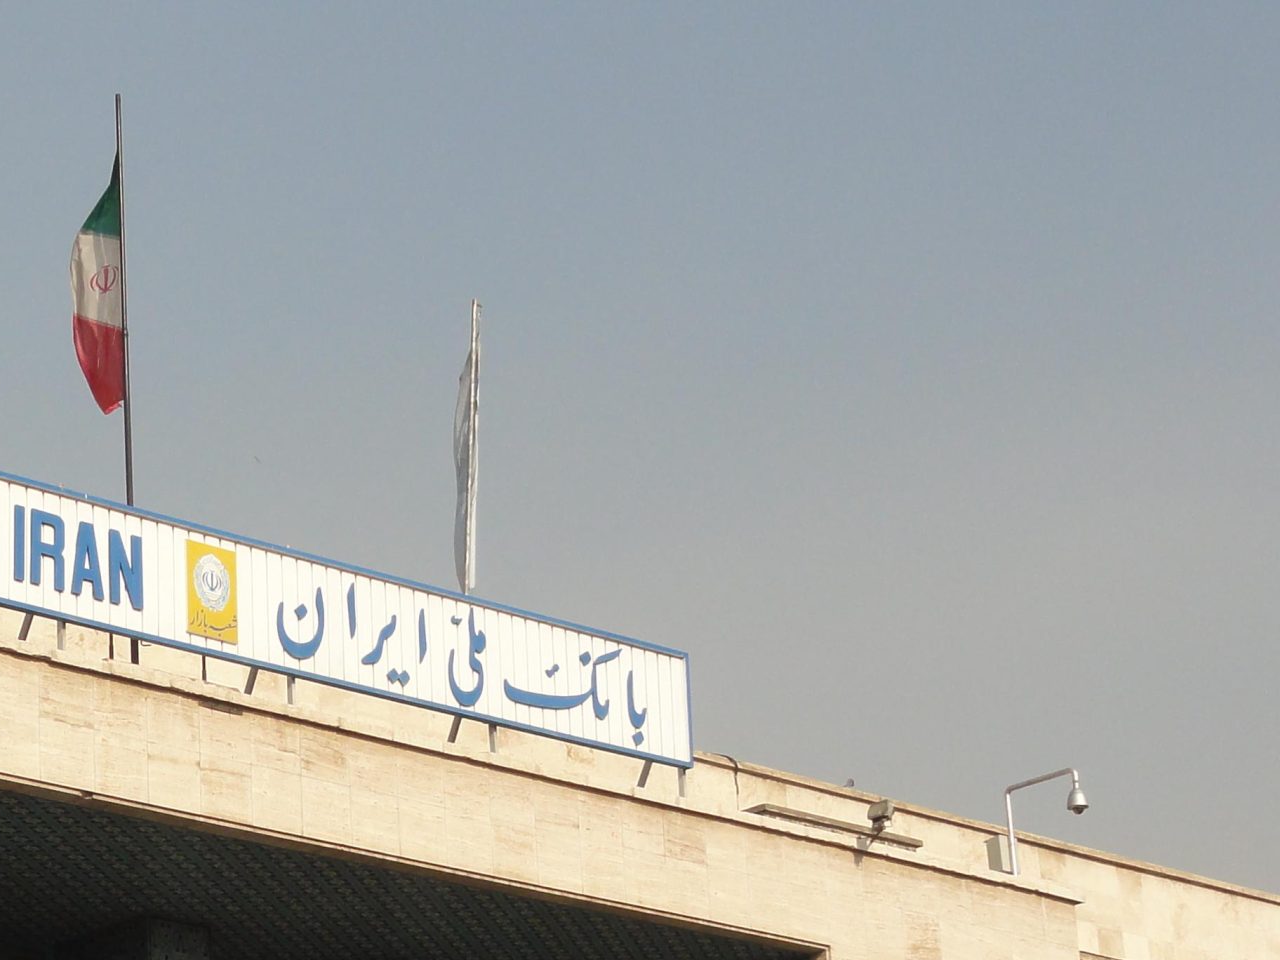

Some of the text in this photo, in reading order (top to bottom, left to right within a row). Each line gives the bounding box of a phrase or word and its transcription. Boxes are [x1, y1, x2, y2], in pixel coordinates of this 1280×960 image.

[13, 505, 144, 611] IRAN
[276, 582, 427, 687] ایران
[504, 648, 647, 747] بانک
